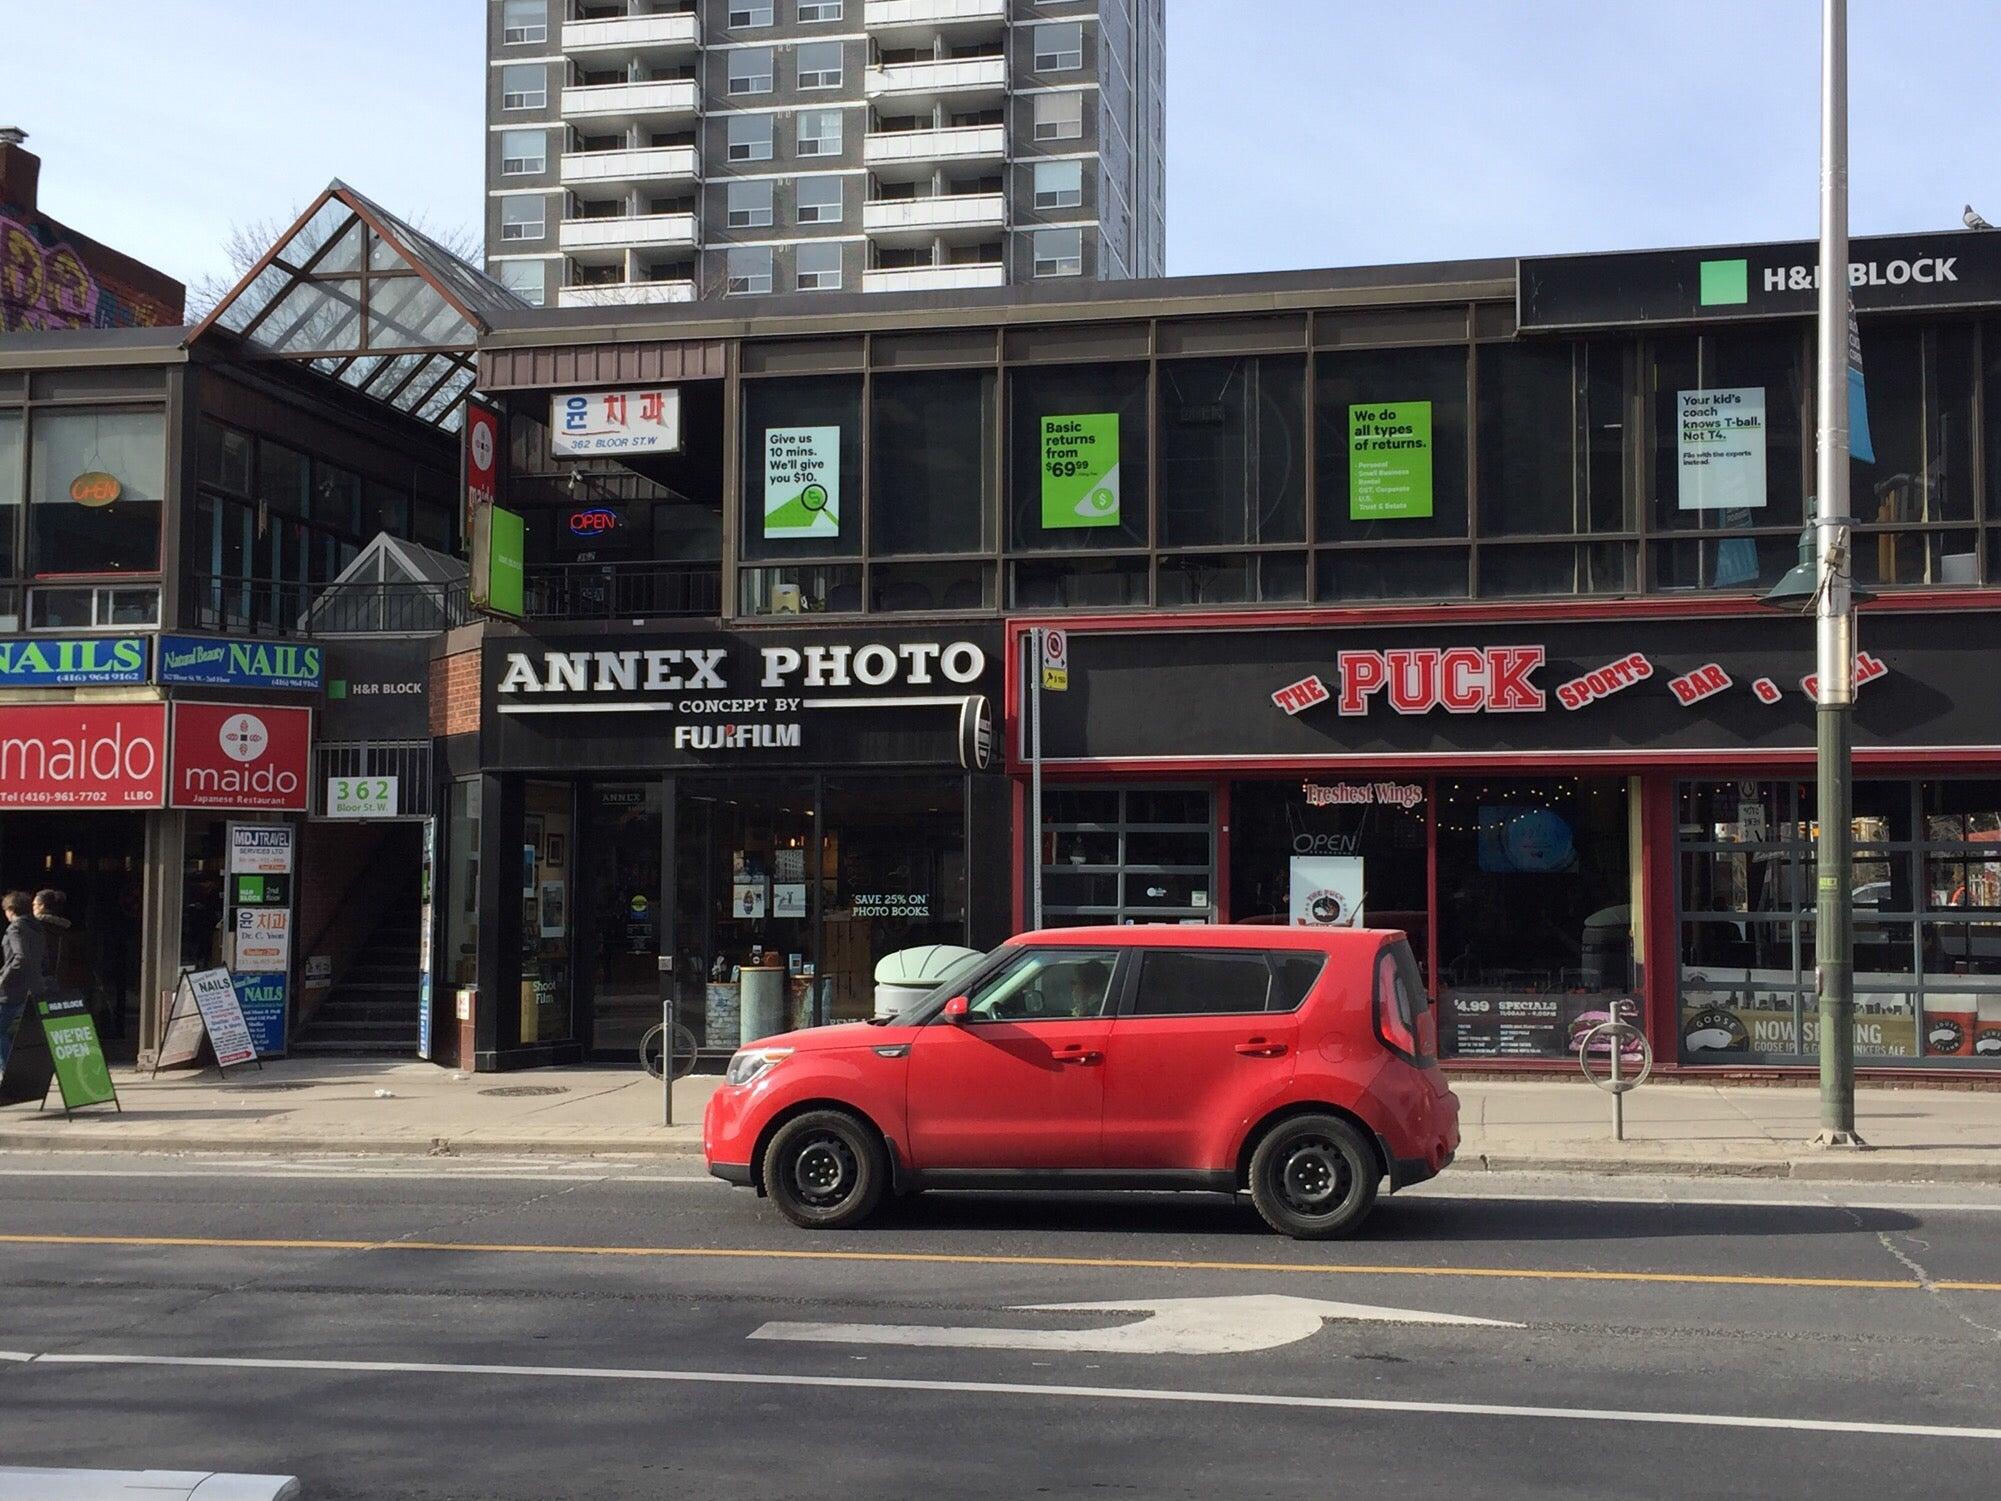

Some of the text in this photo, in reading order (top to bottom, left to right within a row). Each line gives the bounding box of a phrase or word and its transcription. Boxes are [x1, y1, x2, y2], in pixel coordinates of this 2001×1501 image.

[1764, 257, 1958, 292] H& BLOCK
[1683, 394, 1742, 406] Your kid's
[1354, 409, 1397, 422] We do
[1682, 407, 1718, 417] coach
[1046, 421, 1082, 433] Basic
[1683, 416, 1761, 429] knows T-ball.
[1354, 424, 1413, 438] all types
[1683, 430, 1727, 441] Not T4.
[571, 440, 591, 449] 362
[595, 438, 628, 448] BLOOR
[770, 433, 812, 444] Give us
[1046, 434, 1096, 446] returns
[1354, 438, 1427, 451] of returns.
[770, 447, 818, 457] 10 mins.
[1046, 447, 1079, 459] from
[770, 458, 825, 472] We'll give
[770, 472, 818, 486] you $10.
[570, 513, 616, 530] OPEN
[228, 643, 320, 680] NAILS
[497, 640, 986, 693] ANNEX PHOTO
[111, 672, 139, 680] 9162
[1272, 675, 1329, 714] THE
[1337, 645, 1546, 716] PUCK
[1556, 652, 1654, 710] SPORTS
[1668, 663, 1733, 706] BAR
[352, 682, 422, 695] H&R BLOCK
[678, 698, 801, 713] CONCEPT BY
[674, 723, 801, 749] FUJIFILM
[0, 721, 155, 781] maido
[185, 763, 298, 794] maido
[0, 790, 153, 803] Tel (416)-961-7702 LLBO
[336, 780, 389, 801] 362
[1305, 781, 1422, 808] Freshest Wings
[193, 794, 285, 805] Japanese Restaurant
[336, 803, 388, 813] Bloor St. W.
[235, 831, 289, 846] MDJ TRAVEL
[1293, 833, 1357, 853] OPEN
[855, 894, 926, 904] SAVE 25% ON
[852, 906, 889, 917] PHOTO
[199, 978, 232, 993] NAILS
[244, 986, 284, 1002] NAILS
[1454, 999, 1558, 1012] $4.99 SPECIALS
[1696, 1014, 1737, 1030] GOOSE
[50, 1026, 93, 1045] WE'RE
[1754, 1021, 1795, 1040] NOW
[55, 1042, 91, 1060] OPEN
[1754, 1041, 1784, 1052] GOOSE
